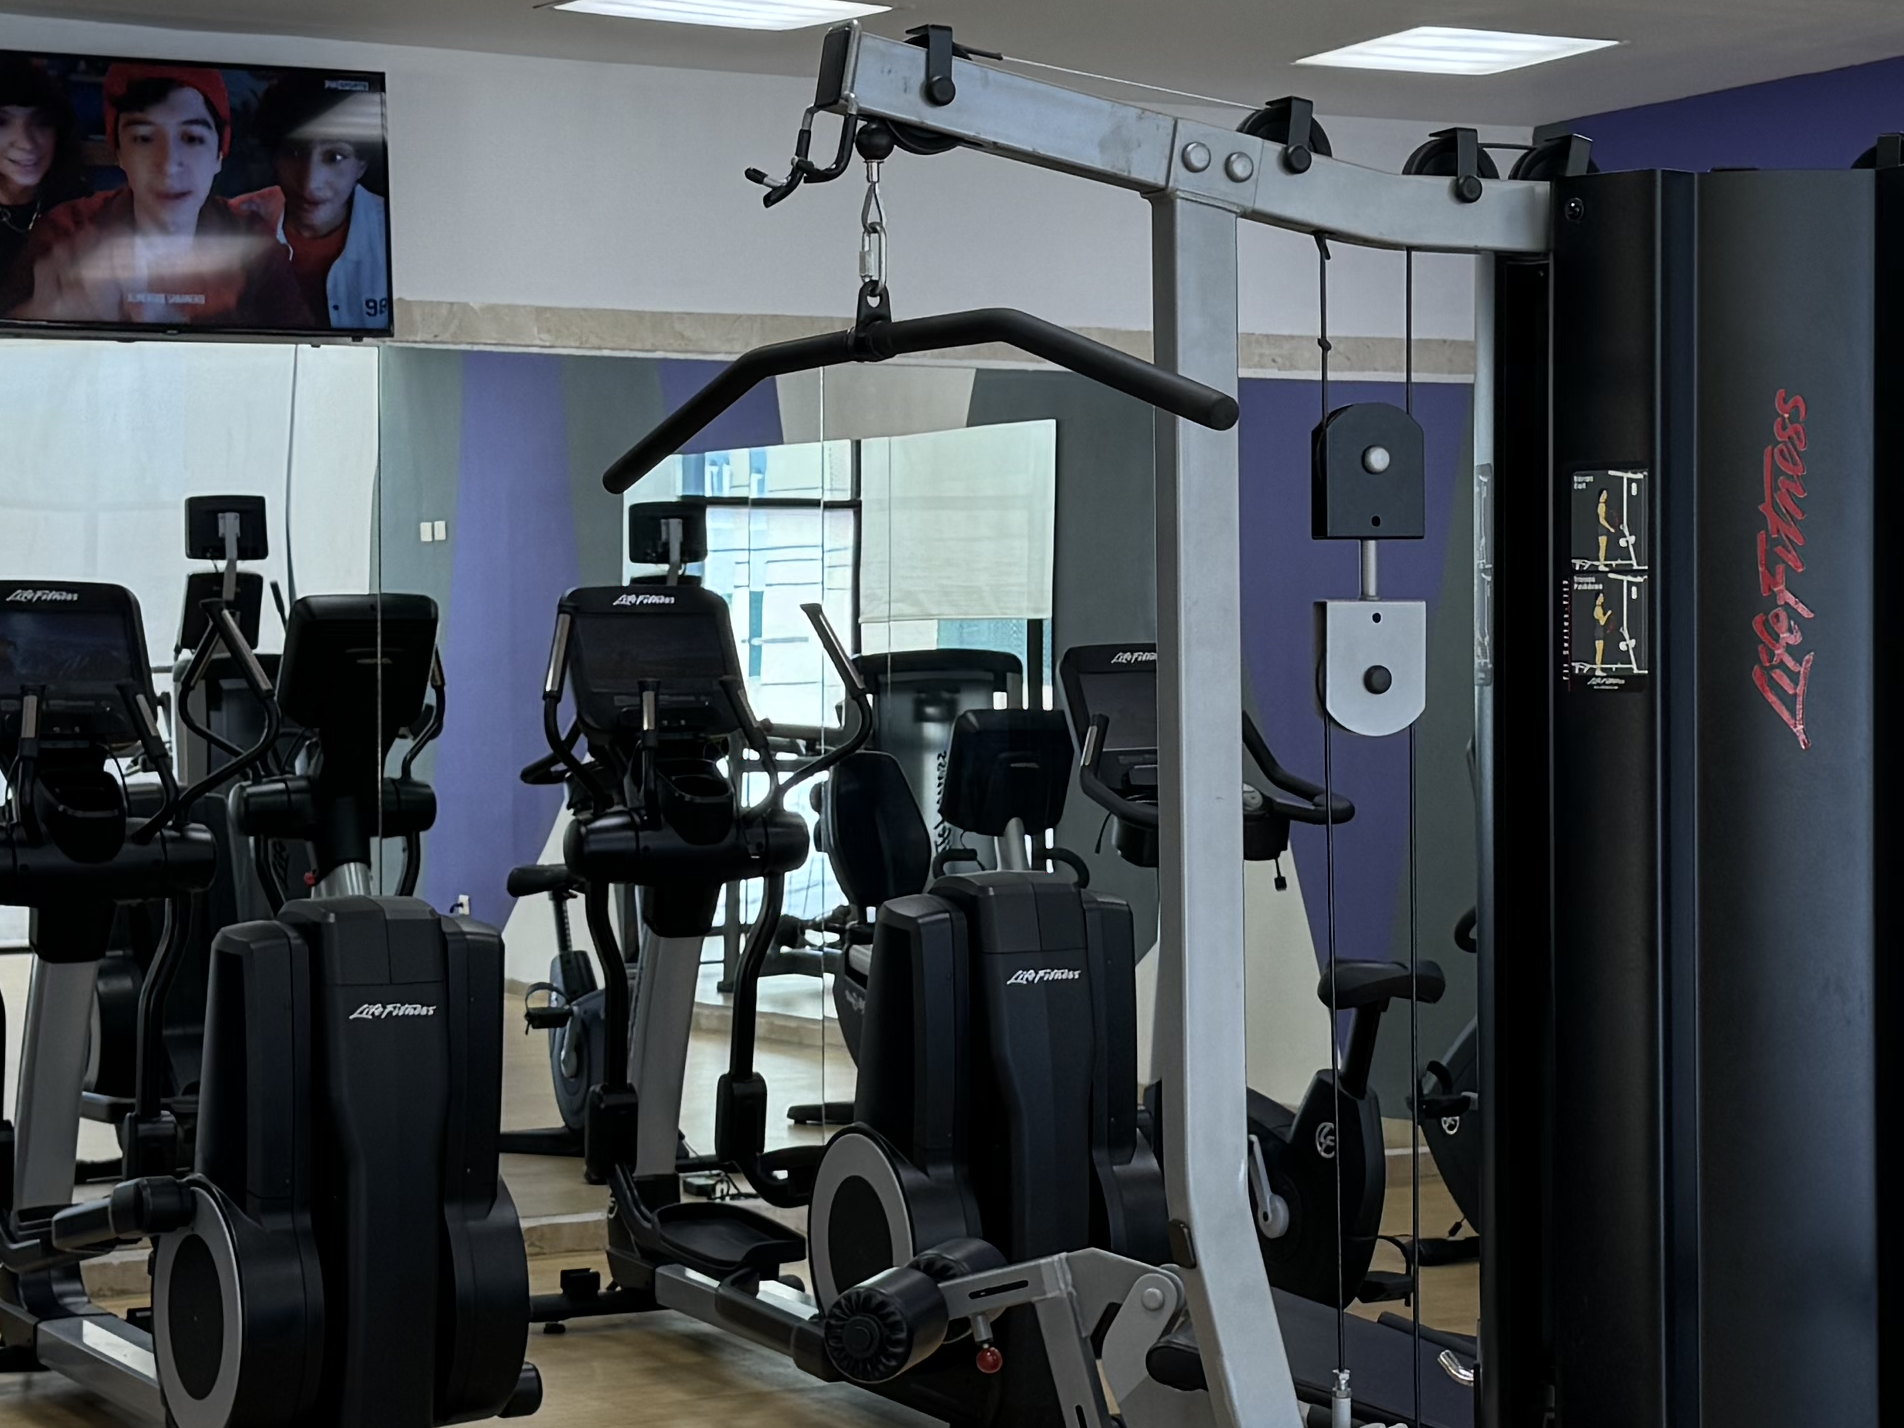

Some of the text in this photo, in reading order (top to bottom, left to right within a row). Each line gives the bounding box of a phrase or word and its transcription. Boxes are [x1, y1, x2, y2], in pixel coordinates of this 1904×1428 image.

[1752, 388, 1815, 750] Life Fitness
[1006, 969, 1082, 985] Life Fitness
[348, 1003, 437, 1020] Life Fitness
